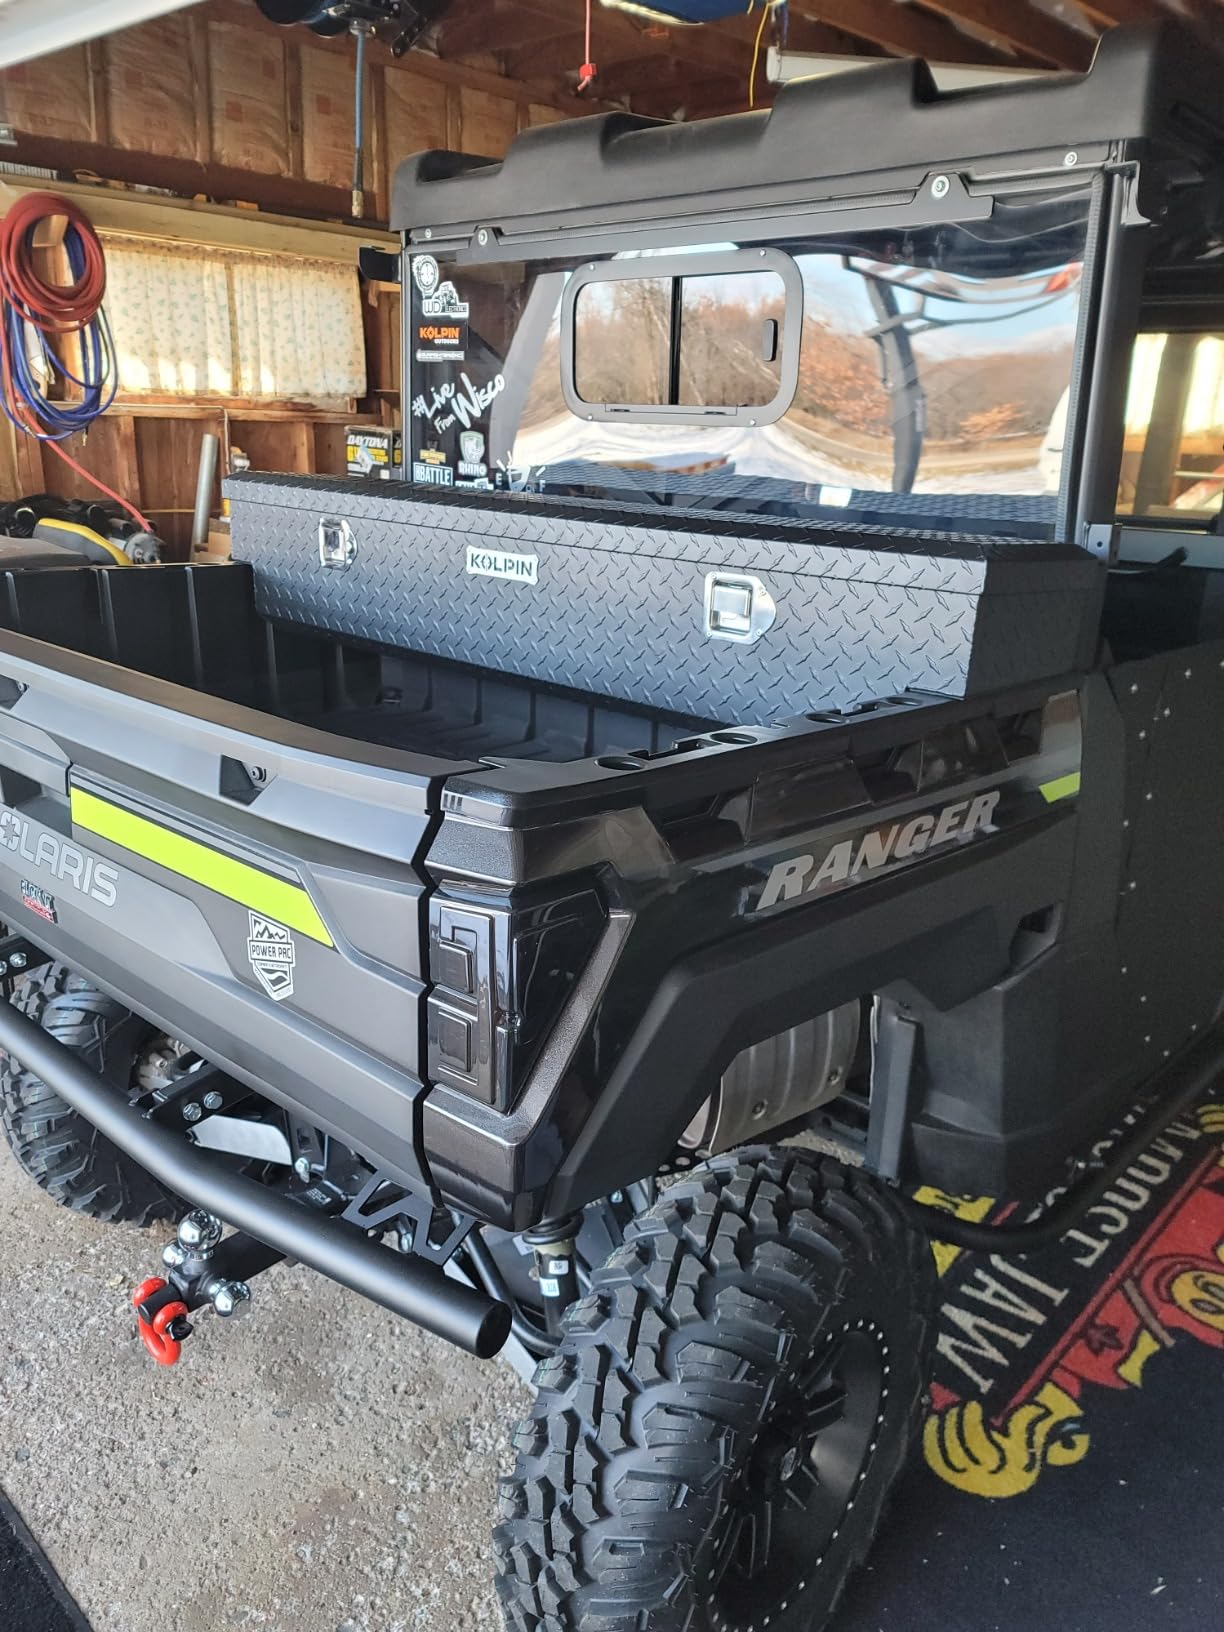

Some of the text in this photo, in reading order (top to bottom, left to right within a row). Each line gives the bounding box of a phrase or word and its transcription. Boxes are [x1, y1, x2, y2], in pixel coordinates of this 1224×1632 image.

[419, 326, 460, 340] KOLPIN
[412, 383, 455, 418] #Live
[434, 372, 505, 434] From Wisco
[347, 434, 388, 449] DAYTONA
[458, 461, 487, 477] RHINO
[471, 553, 532, 577] KOLPIN
[0, 811, 119, 907] OLARIS
[755, 790, 1000, 911] RANGER
[251, 944, 292, 960] POWER PAC
